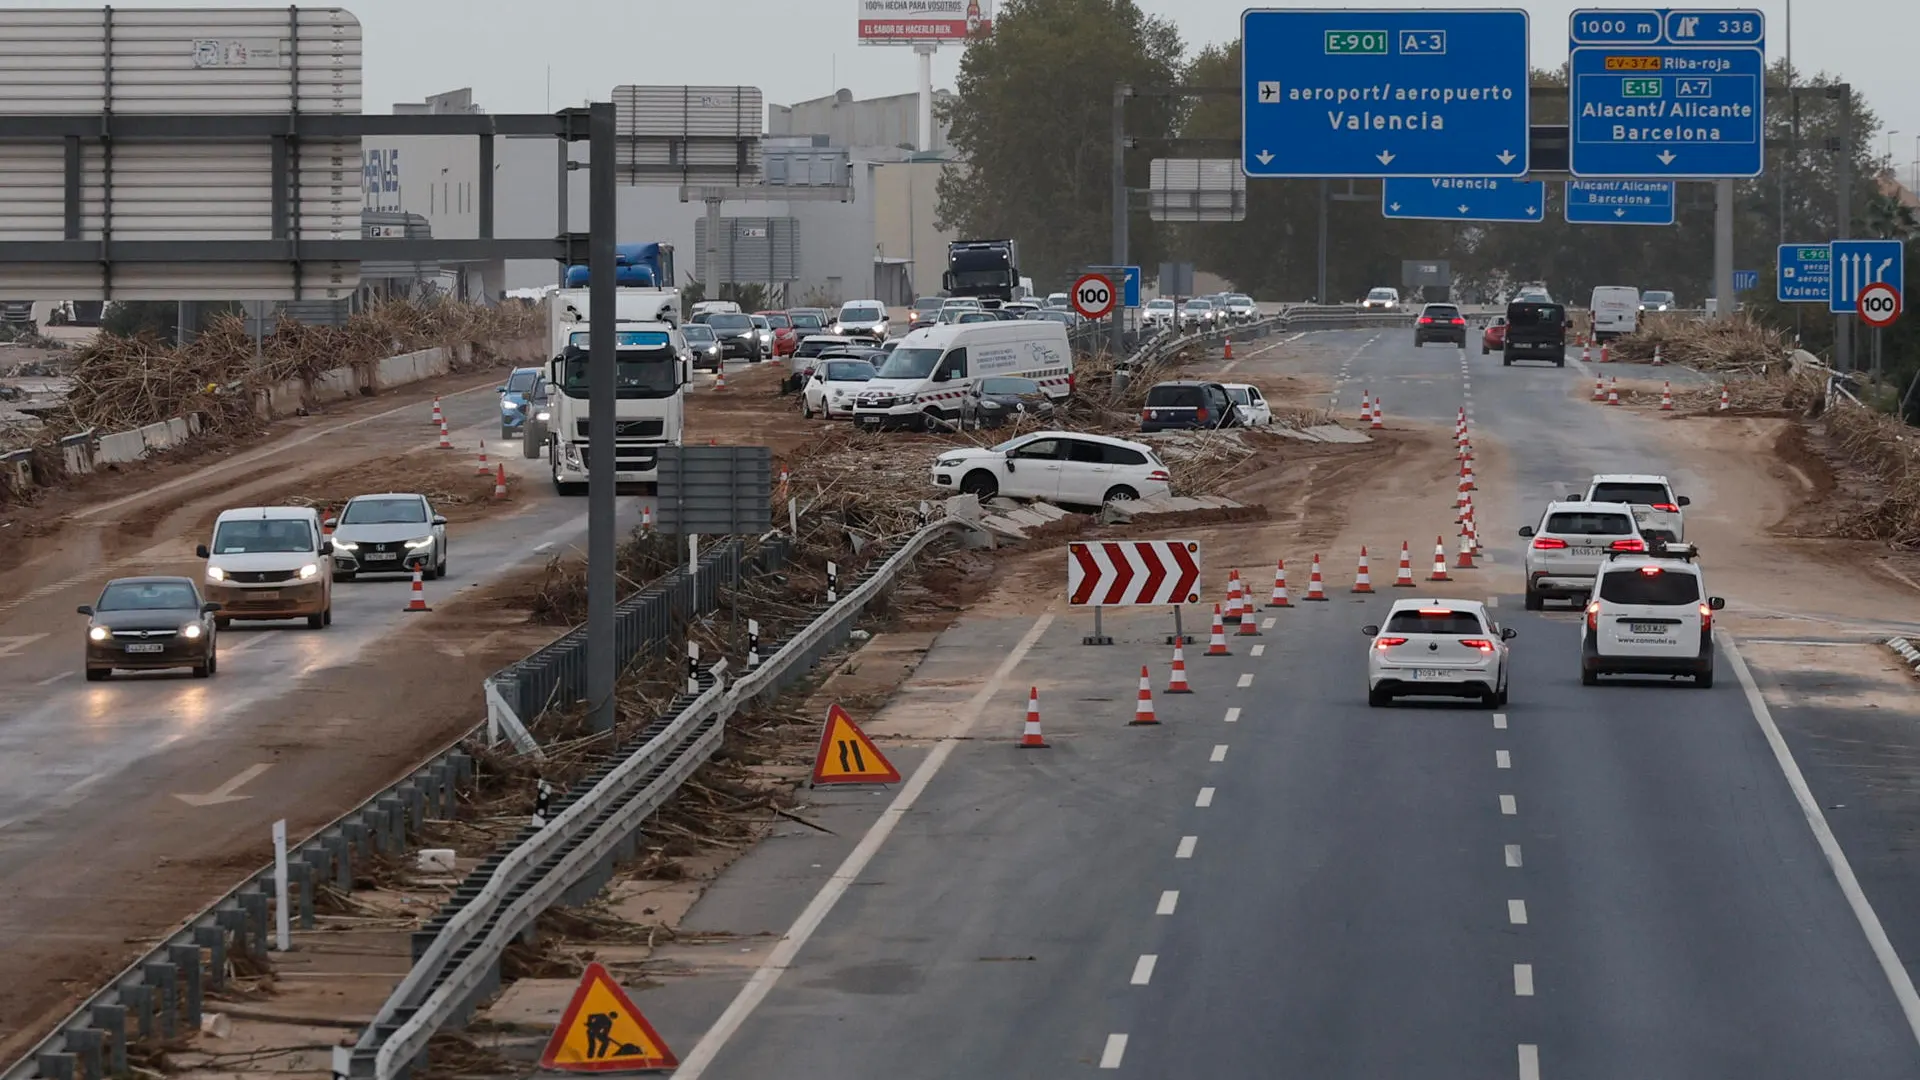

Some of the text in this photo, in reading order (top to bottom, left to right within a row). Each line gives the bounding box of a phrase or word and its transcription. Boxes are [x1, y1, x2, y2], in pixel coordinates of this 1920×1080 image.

[865, 1, 884, 10] 100%
[885, 1, 907, 10] HECHA
[909, 1, 926, 10] PARA
[864, 25, 872, 34] EL
[873, 25, 895, 34] SABOR
[895, 25, 904, 34] DE
[905, 25, 934, 34] HACERLO
[1581, 20, 1651, 34] 1000 m
[1717, 20, 1754, 34] 338
[1328, 34, 1442, 50] E-901 A-3
[1606, 57, 1731, 72] CV-374 Riba-roja
[1625, 81, 1708, 94] E-15 A-7
[1327, 111, 1444, 130] Valencia
[1612, 125, 1721, 141] Barcelona
[1431, 178, 1498, 190] Valencia
[1588, 193, 1652, 205] Barcelona
[1078, 288, 1109, 304] 100
[1863, 297, 1894, 312] 100
